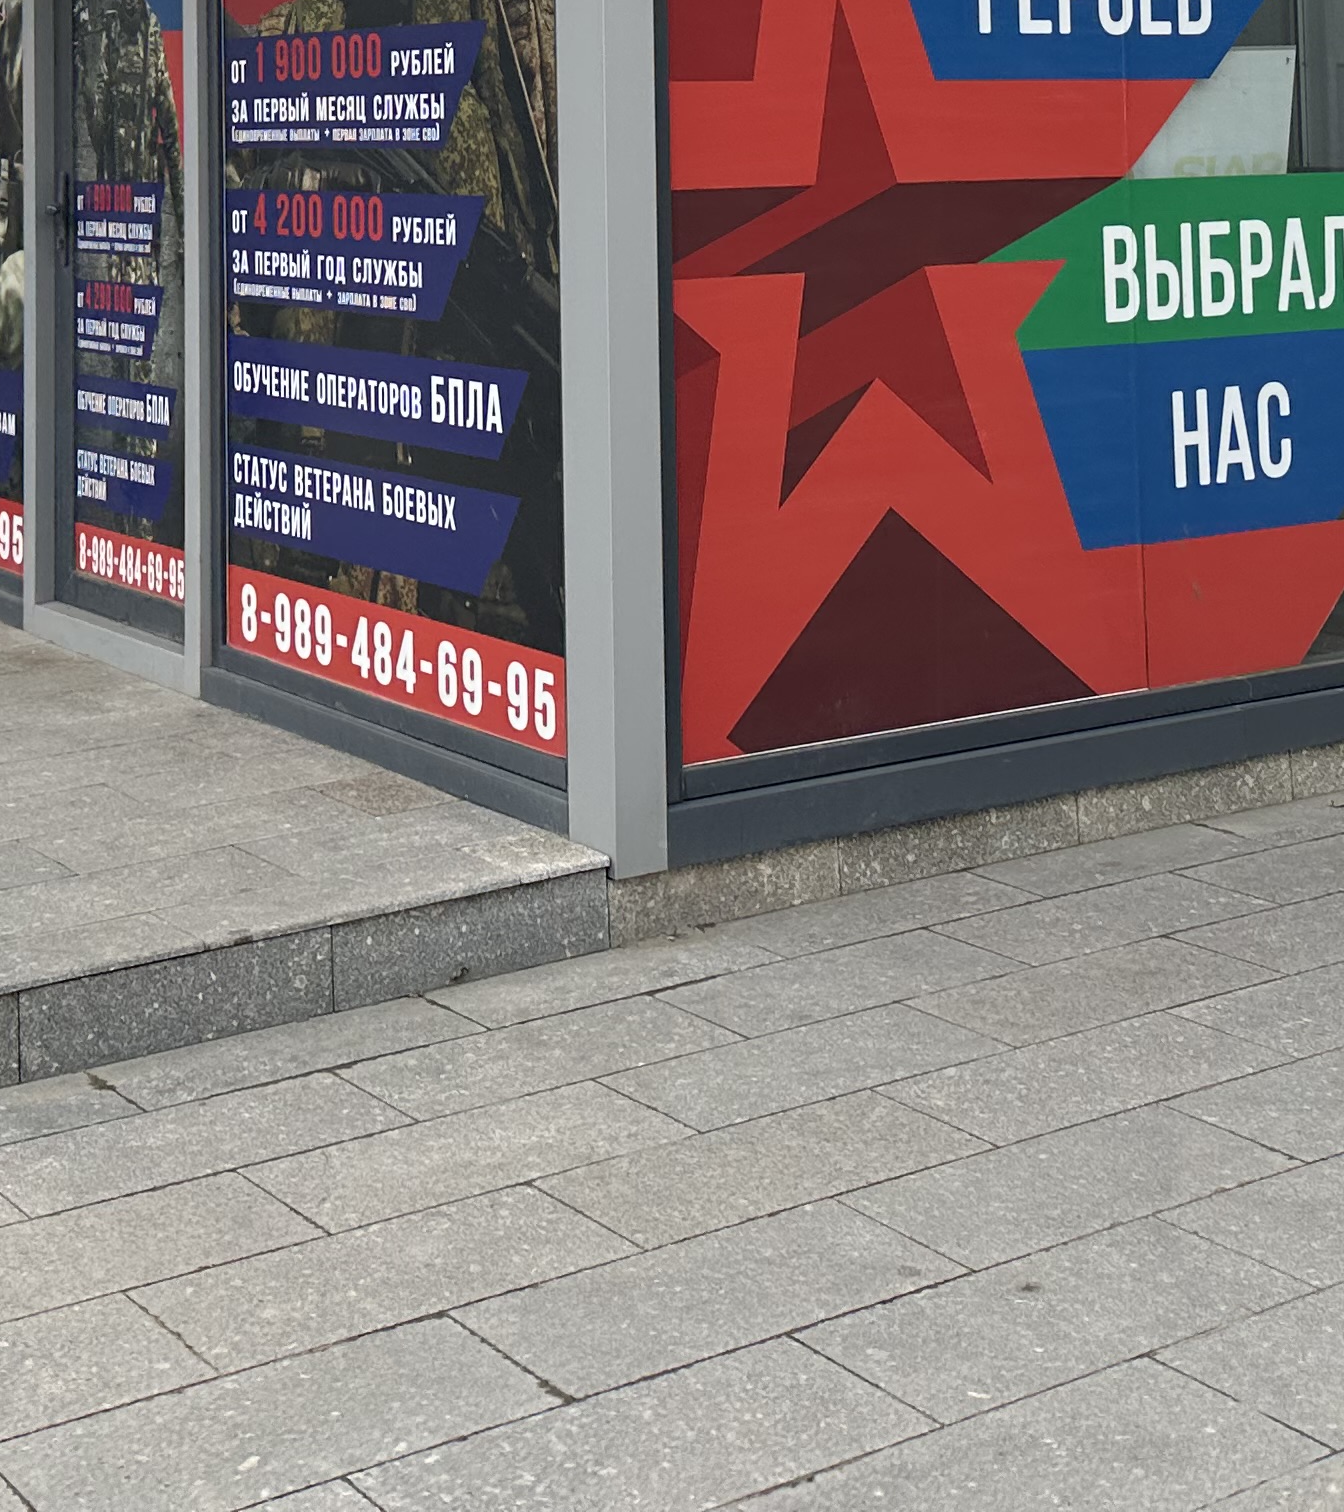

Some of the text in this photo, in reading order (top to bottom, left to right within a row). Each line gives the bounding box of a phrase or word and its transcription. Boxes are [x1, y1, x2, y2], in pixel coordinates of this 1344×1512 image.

[231, 32, 455, 84] ОТ 1 900 000 РУБЛЕЙ
[231, 92, 445, 124] ЗА ПЕРВЫЙ МЕСЯЦ СЛУЖБЫ
[395, 127, 400, 141] В
[232, 193, 457, 246] ОТ 4 200 000 РУБЛЕЙ
[232, 249, 423, 288] ЗА ПЕРВЫЙ ГОД СЛУЖБЫ
[372, 295, 378, 308] В
[77, 389, 170, 427] ОБУЧЕНИЕ ОПЕРАТОРОВ БПЛА
[233, 361, 503, 434] ОБУЧЕНИЕ ОПЕРАТОРОВ БПЛА
[1171, 381, 1293, 489] НАС
[77, 449, 155, 486] СТАТУС ВЕТЕРАНА БОЕВЫХ
[77, 474, 107, 501] ДЕЙСТВИЙ
[233, 452, 456, 531] СТАТУС ВЕТЕРАНА БОЕВЫХ
[233, 492, 312, 541] ДЕЙСТВИЙ
[79, 532, 184, 600] 8-989-484-69-95
[241, 583, 556, 740] 8-989-484-69-95
